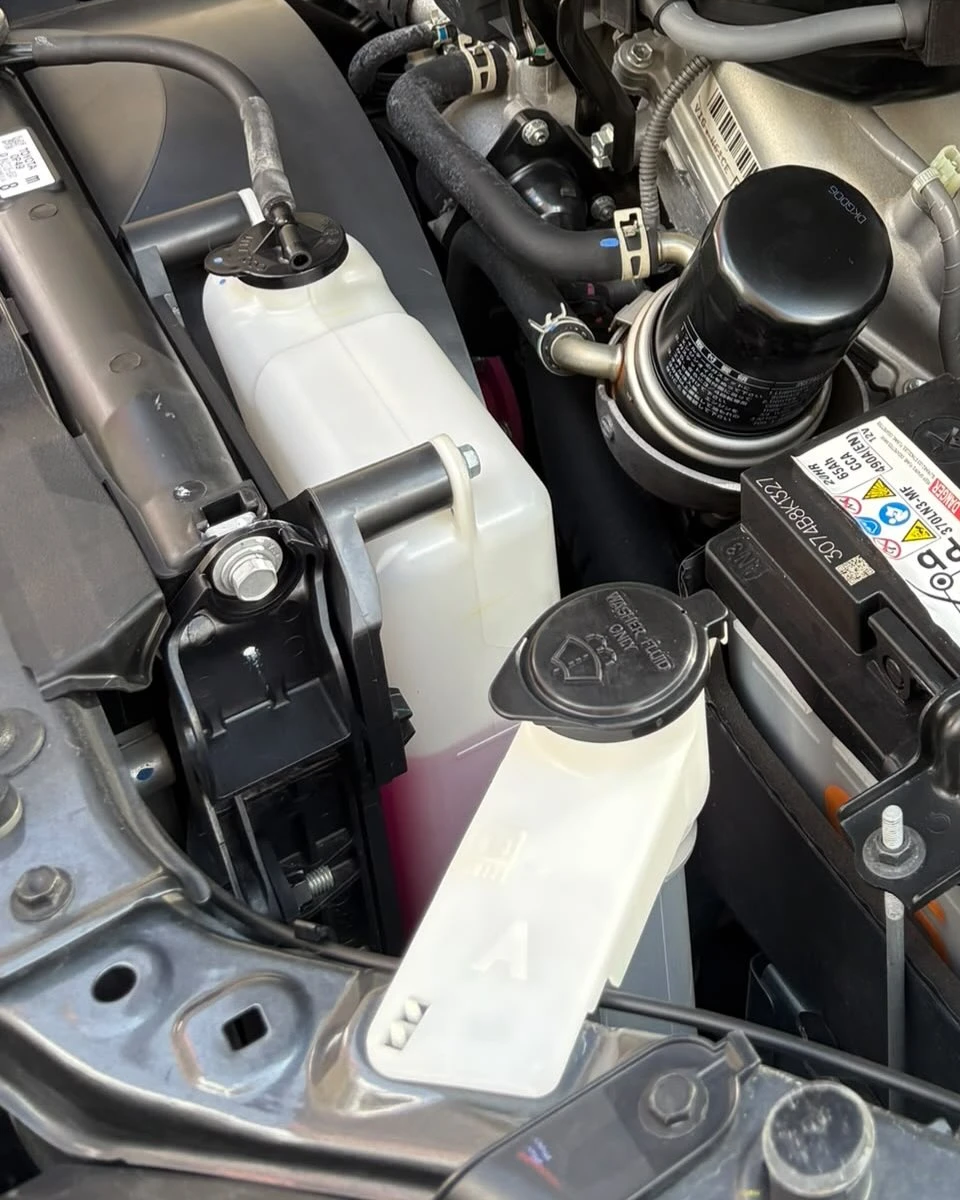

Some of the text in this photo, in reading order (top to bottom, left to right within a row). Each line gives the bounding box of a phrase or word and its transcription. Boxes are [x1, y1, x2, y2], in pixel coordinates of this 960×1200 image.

[861, 427, 877, 443] 12V
[840, 451, 862, 471] CCA
[846, 431, 885, 473] 490A(EN)
[824, 457, 849, 480] 65Ah
[899, 486, 953, 536] 370LN3-MF
[932, 481, 960, 512] DANGER
[755, 477, 843, 564] 3074B8K1327
[606, 591, 676, 671] WASHER FLUID
[609, 623, 640, 651] ONLY
